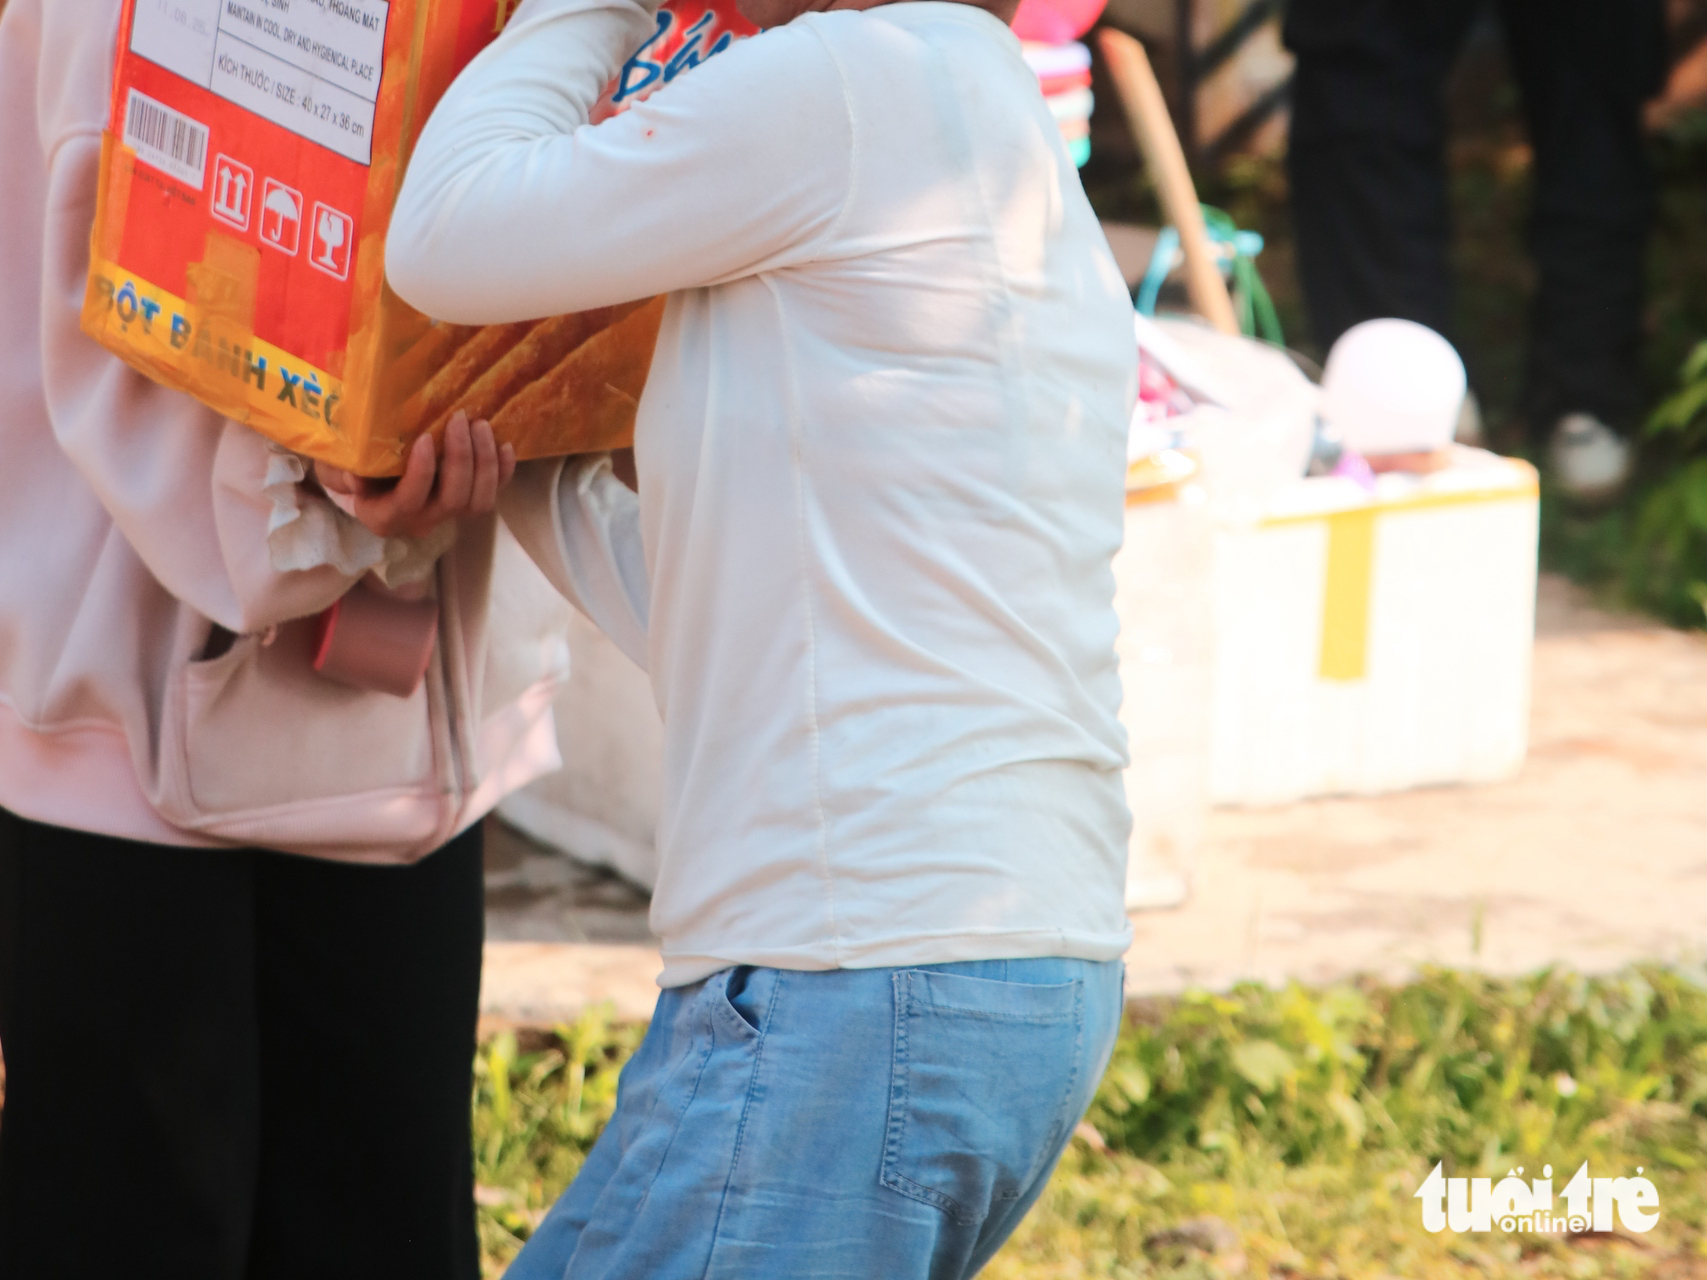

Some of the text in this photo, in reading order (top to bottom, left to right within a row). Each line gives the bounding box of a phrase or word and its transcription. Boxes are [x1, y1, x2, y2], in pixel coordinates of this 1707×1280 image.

[227, 0, 256, 27] MAINTAIN
[256, 14, 264, 30] IN
[283, 26, 298, 47] DRY
[298, 33, 312, 53] AND
[311, 40, 350, 72] HYGIENICAL
[351, 58, 375, 82] PLACE
[362, 9, 381, 33] MÁT
[218, 52, 239, 78] KÍCH
[240, 63, 271, 93] THƯỚC
[276, 83, 296, 107] SIZE
[301, 94, 313, 112] 40
[320, 102, 332, 122] 27
[339, 111, 350, 131] 36
[351, 121, 365, 138] cm
[93, 271, 162, 336] BỘT
